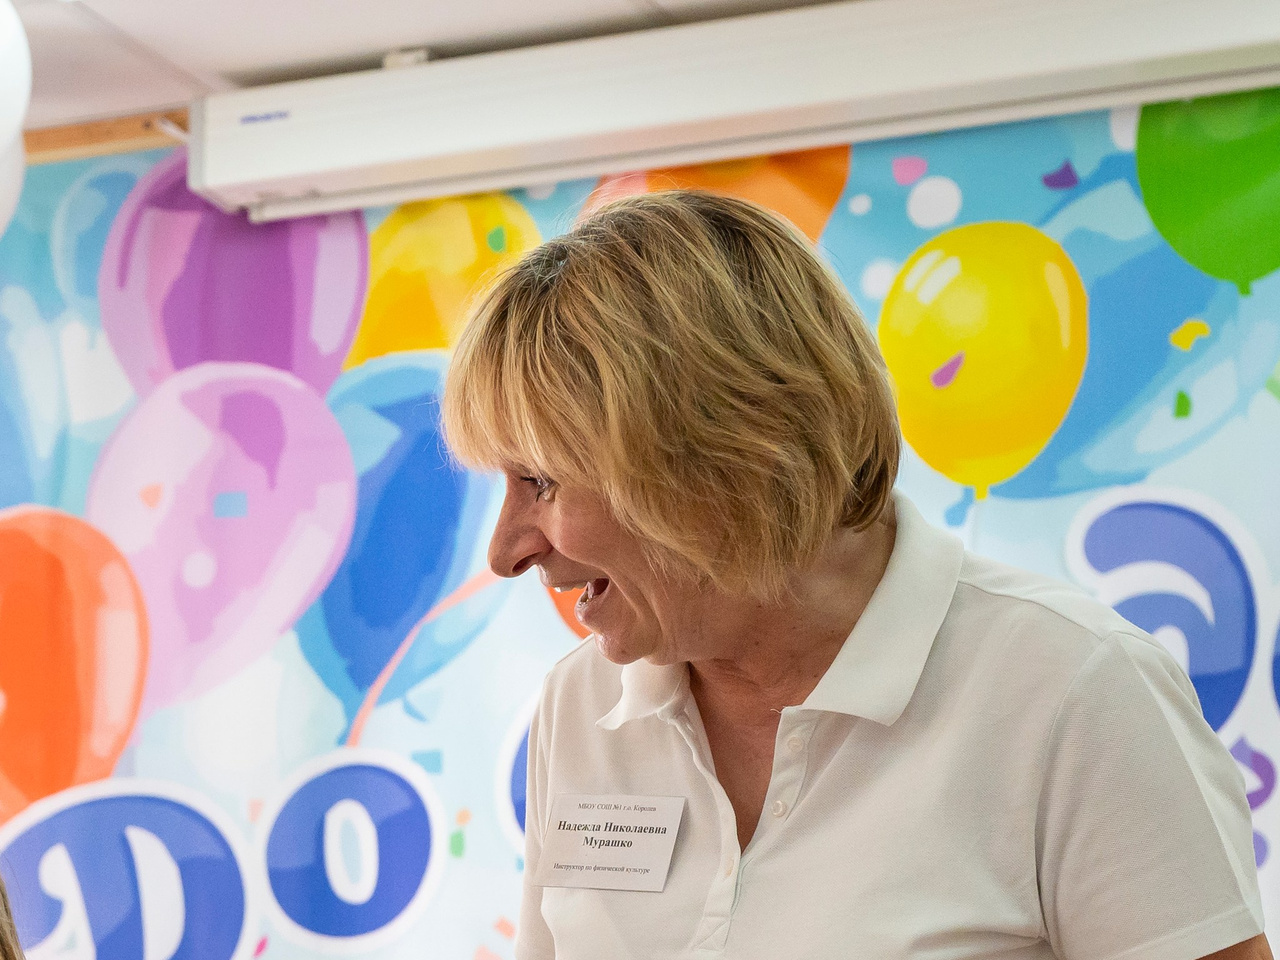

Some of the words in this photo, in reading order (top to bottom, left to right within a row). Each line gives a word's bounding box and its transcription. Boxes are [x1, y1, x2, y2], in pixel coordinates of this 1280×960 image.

[558, 820, 601, 832] Надежда
[604, 822, 667, 835] Николаевна
[583, 836, 633, 849] Мурашко
[553, 863, 584, 872] Инструктор
[626, 867, 650, 875] культуре
